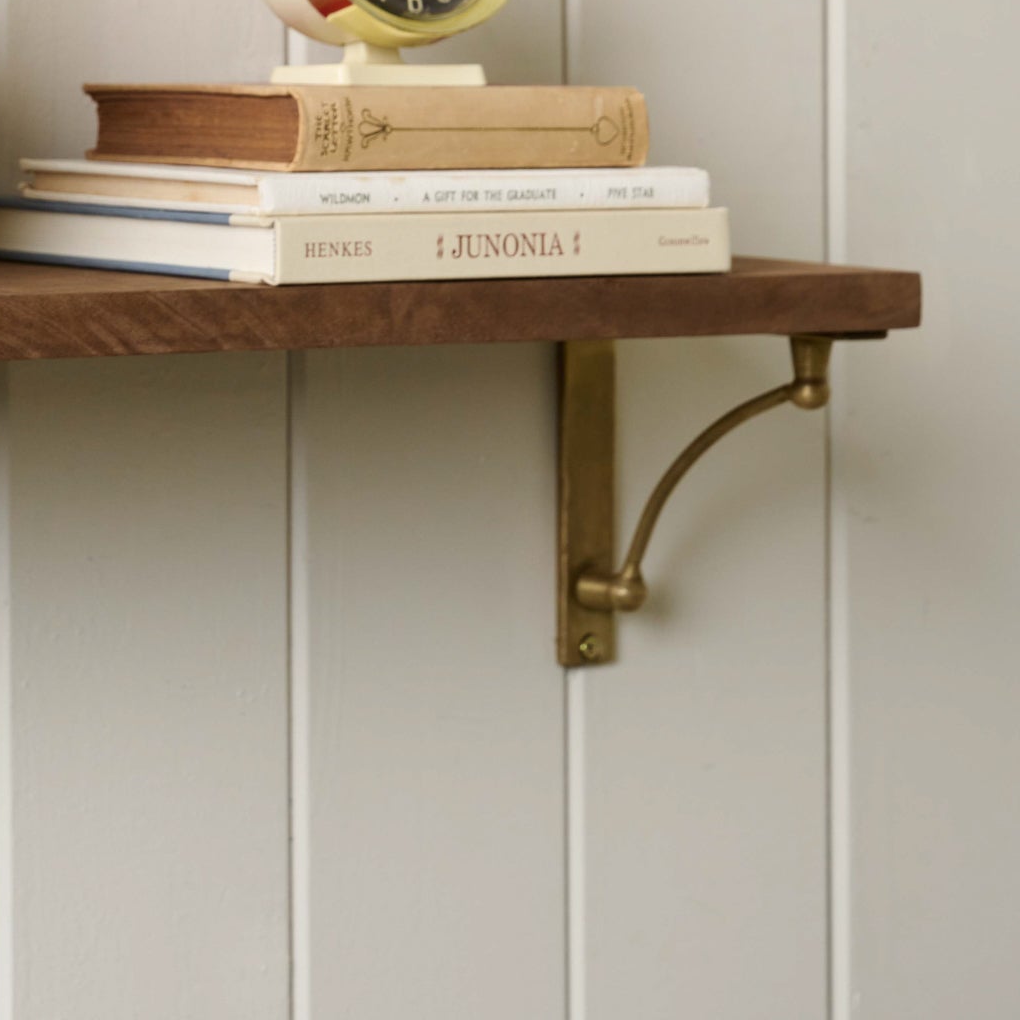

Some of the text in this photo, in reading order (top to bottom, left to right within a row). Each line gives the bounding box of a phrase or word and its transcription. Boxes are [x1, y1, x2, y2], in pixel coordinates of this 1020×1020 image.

[314, 115, 323, 141] THE
[319, 192, 371, 205] WILDMON
[423, 188, 557, 202] A GIFT FOR THE GRADUATE
[304, 240, 373, 259] HENKES
[451, 232, 564, 259] JUNONIA
